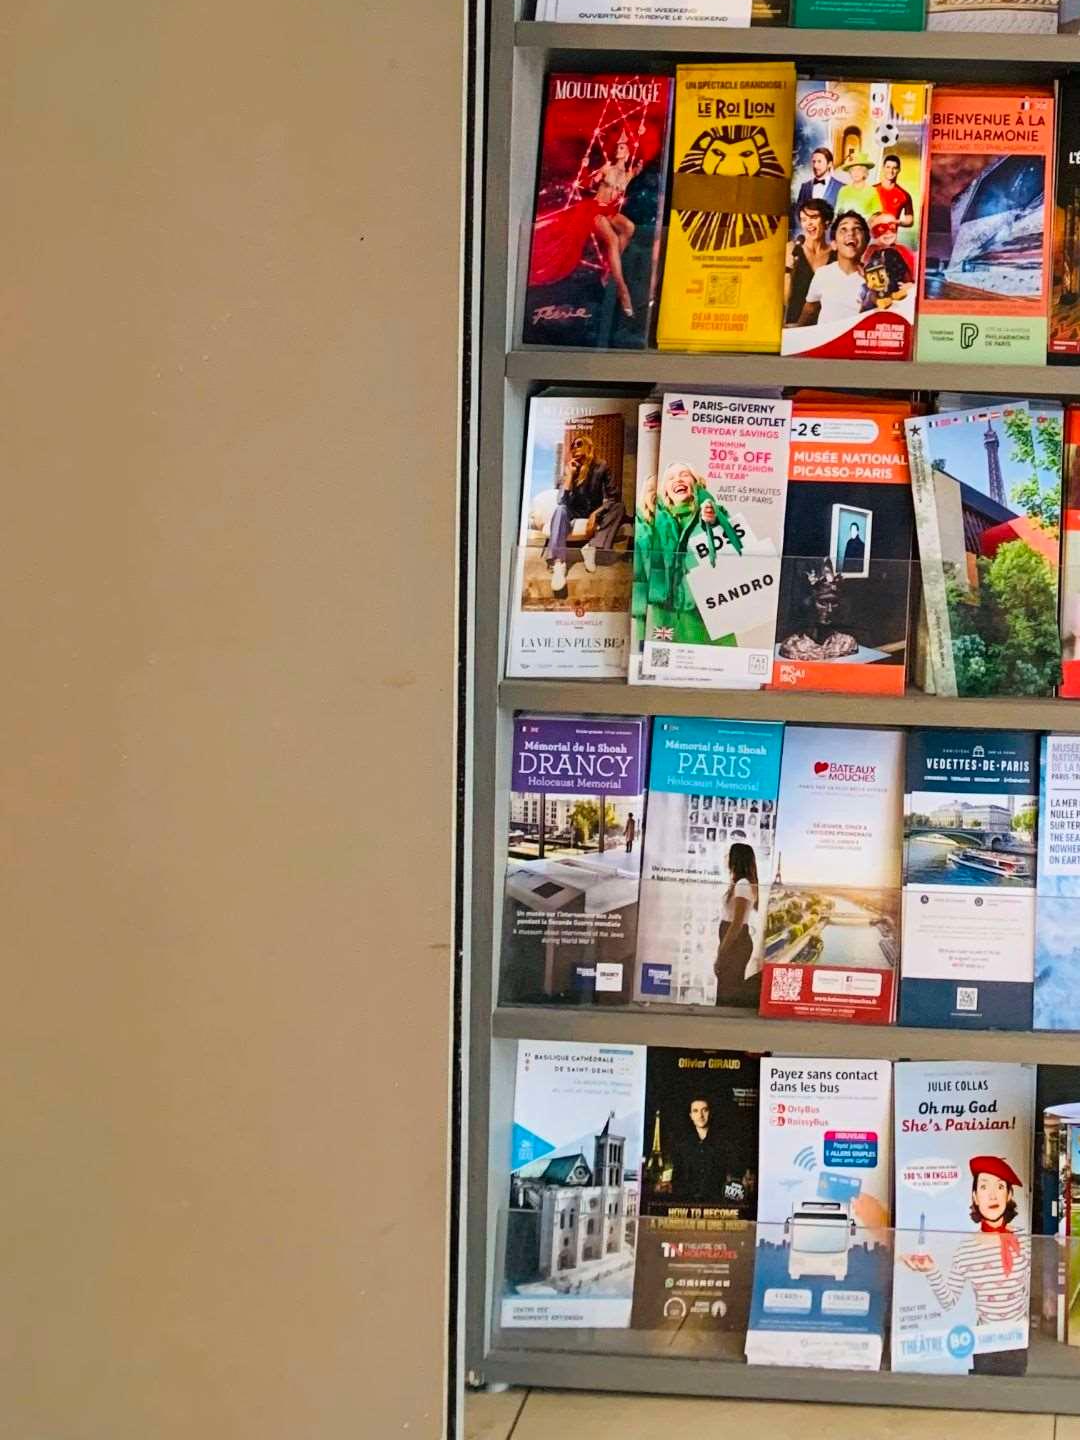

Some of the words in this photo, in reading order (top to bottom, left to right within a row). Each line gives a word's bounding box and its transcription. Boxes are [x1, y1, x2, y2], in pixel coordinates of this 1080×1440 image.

[555, 80, 609, 100] MOULIN
[610, 82, 662, 103] ROUGE
[932, 113, 1011, 126] BIENVENUE
[1015, 111, 1024, 126] À
[1028, 114, 1046, 126] LA
[931, 128, 1040, 142] PHILHARMONIE
[693, 400, 775, 413] PARIS-GIVERNY
[692, 413, 744, 424] DESIGNER
[746, 417, 786, 427] OUTLET
[691, 426, 737, 436] EVERYDAY
[738, 430, 780, 439] SAVINGS
[709, 440, 746, 448] MINIMUM
[709, 449, 739, 462] 30%
[743, 451, 772, 463] OFF
[794, 449, 839, 464] MUSÉE
[841, 453, 908, 465] NATIONAL
[708, 463, 735, 471] GREAT
[737, 464, 774, 473] FASHION
[793, 465, 893, 479] PICASSO-PARIS
[705, 574, 774, 609] SANDRO
[524, 740, 571, 752] Mémorial
[572, 742, 584, 752] de
[586, 742, 596, 753] la
[598, 743, 628, 754] Shoah
[665, 739, 711, 752] Mémorial
[712, 741, 724, 752] de
[726, 743, 736, 753] la
[737, 744, 767, 755] Shoah
[518, 752, 634, 777] DRANCY
[677, 752, 751, 779] PARIS
[829, 762, 877, 774] BATEAUX
[982, 759, 994, 771] DE
[1000, 760, 1030, 772] PARIS
[528, 776, 575, 787] Holocaust
[577, 778, 622, 789] Memorial
[667, 776, 713, 788] Holocaust
[715, 779, 760, 791] Memorial
[828, 773, 876, 783] MOUCHES
[1050, 799, 1061, 808] LA
[1062, 799, 1078, 808] MER
[1050, 810, 1075, 819] NULLE
[1050, 821, 1066, 830] SUR
[1050, 832, 1063, 842] THE
[1065, 832, 1080, 842] SEA
[1049, 855, 1060, 865] ON
[678, 1057, 707, 1068] Olivier
[707, 1058, 741, 1069] GIRAUD
[770, 1068, 804, 1081] Payez
[807, 1070, 832, 1080] sans
[835, 1070, 879, 1081] contact
[770, 1081, 797, 1092] dans
[800, 1081, 817, 1093] les
[819, 1083, 840, 1093] bus
[928, 1080, 952, 1093] JULIE
[955, 1079, 989, 1092] COLLAS
[787, 1105, 820, 1114] OrlyBus
[918, 1101, 939, 1115] Oh
[941, 1104, 966, 1117] my
[968, 1099, 998, 1113] God
[787, 1118, 829, 1127] RoissyBus
[901, 1118, 943, 1133] She's
[944, 1116, 1016, 1132] Parisian!
[932, 1170, 958, 1179] ENGLISH
[667, 1207, 689, 1217] HOW
[690, 1208, 702, 1217] TO
[703, 1208, 740, 1218] BECOME
